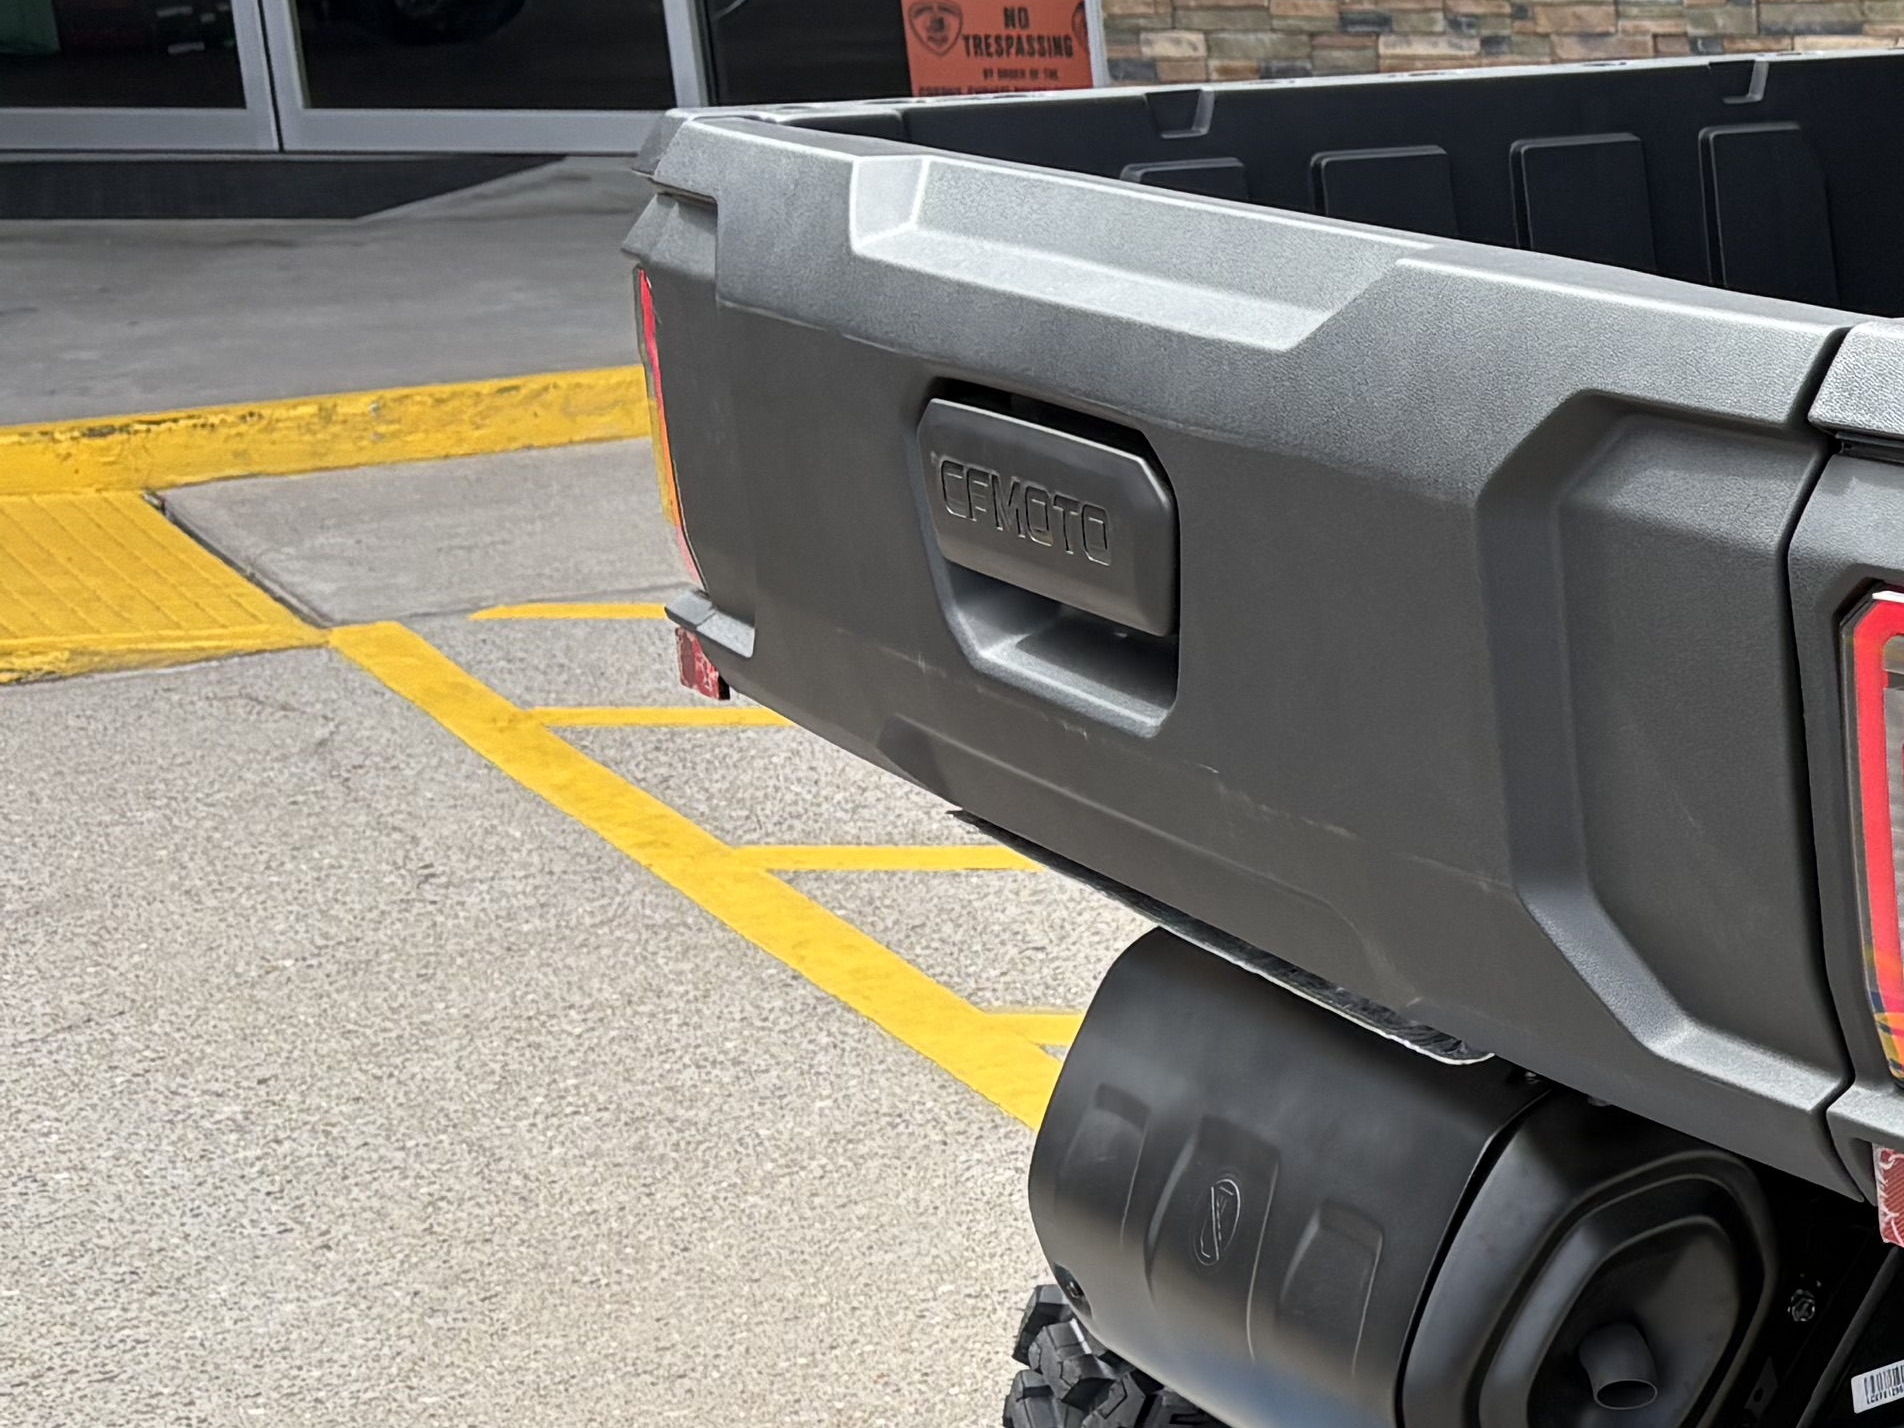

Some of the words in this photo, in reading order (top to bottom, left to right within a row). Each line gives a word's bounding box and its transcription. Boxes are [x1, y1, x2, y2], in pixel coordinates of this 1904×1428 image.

[1003, 7, 1030, 29] NO
[963, 35, 1074, 59] TRESPASSING
[940, 456, 1112, 566] CFMOTO
